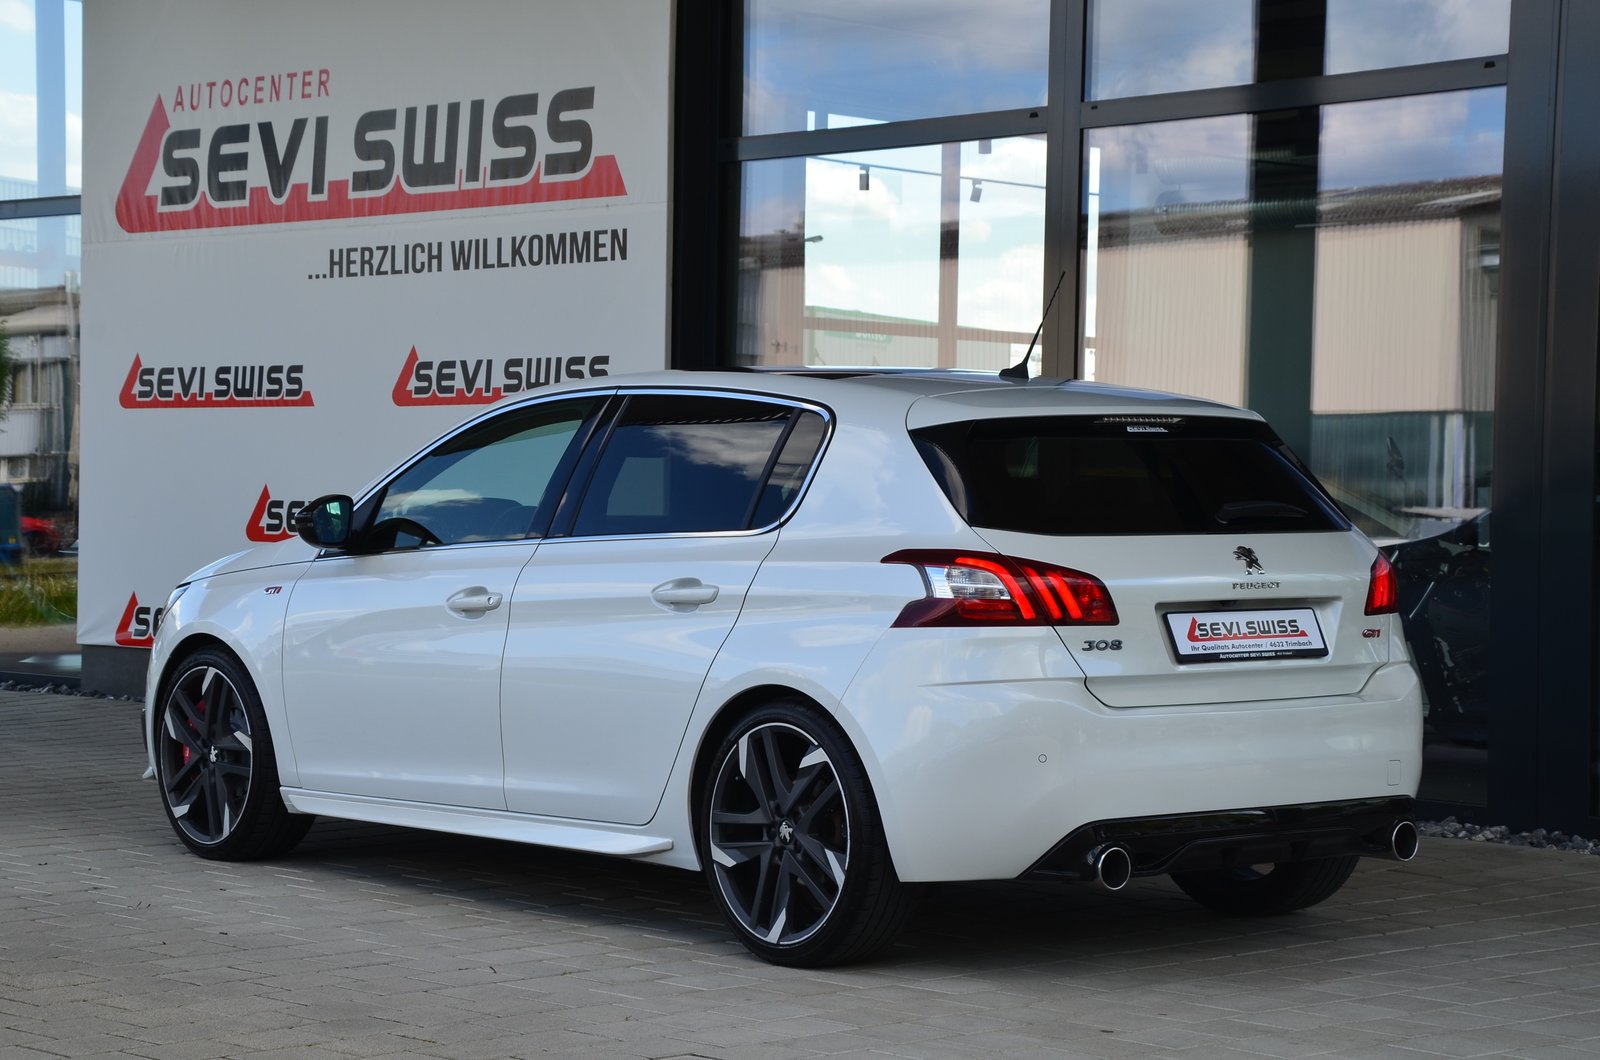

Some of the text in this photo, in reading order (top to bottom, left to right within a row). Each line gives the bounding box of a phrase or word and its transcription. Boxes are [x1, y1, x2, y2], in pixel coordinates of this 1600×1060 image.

[173, 69, 330, 112] AUTOCENTER
[160, 86, 595, 207] SEVI SWISS
[451, 228, 628, 270] WILLKOMMEN
[137, 364, 304, 399] SEVI SWISS
[413, 355, 610, 396] SEVI SWISS
[266, 500, 311, 532] SE
[1232, 582, 1280, 590] PEUGEOT
[1197, 620, 1300, 637] SEVI SWISS
[1082, 640, 1123, 651] 308
[1231, 642, 1263, 650] Autocenter
